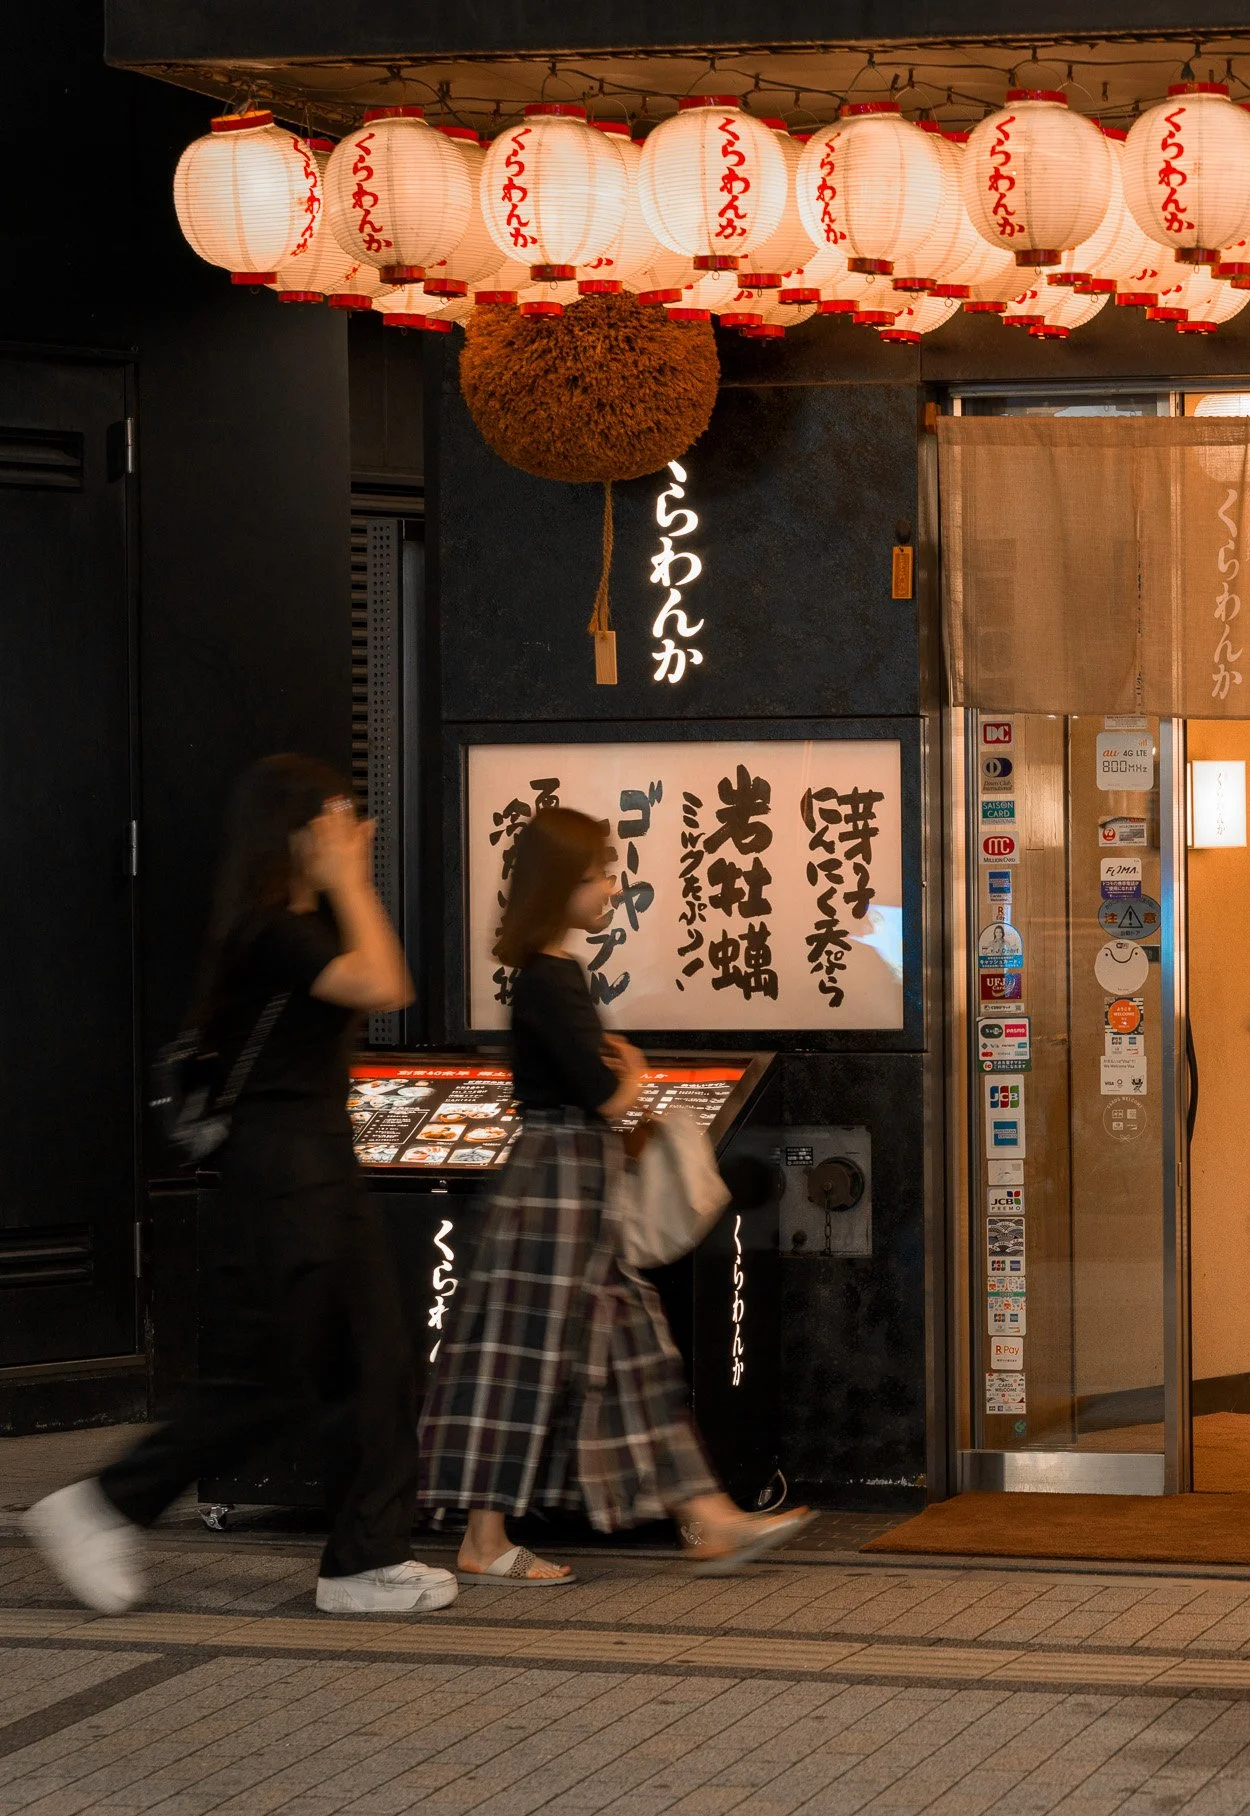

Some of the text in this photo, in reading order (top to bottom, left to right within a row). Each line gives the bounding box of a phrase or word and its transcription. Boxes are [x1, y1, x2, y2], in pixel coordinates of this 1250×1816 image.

[352, 132, 393, 253] くらわんか
[502, 128, 538, 249] くらわんか
[715, 117, 751, 240] くらわんか
[815, 132, 847, 246] くらわんか
[988, 116, 1026, 238] くらわんか
[1158, 107, 1196, 233] くらわんか
[1211, 488, 1244, 700] くらわんか
[982, 801, 1014, 810] SAISON
[987, 810, 1010, 818] CARD
[991, 1198, 1014, 1206] JCB
[1003, 1345, 1020, 1356] Pay
